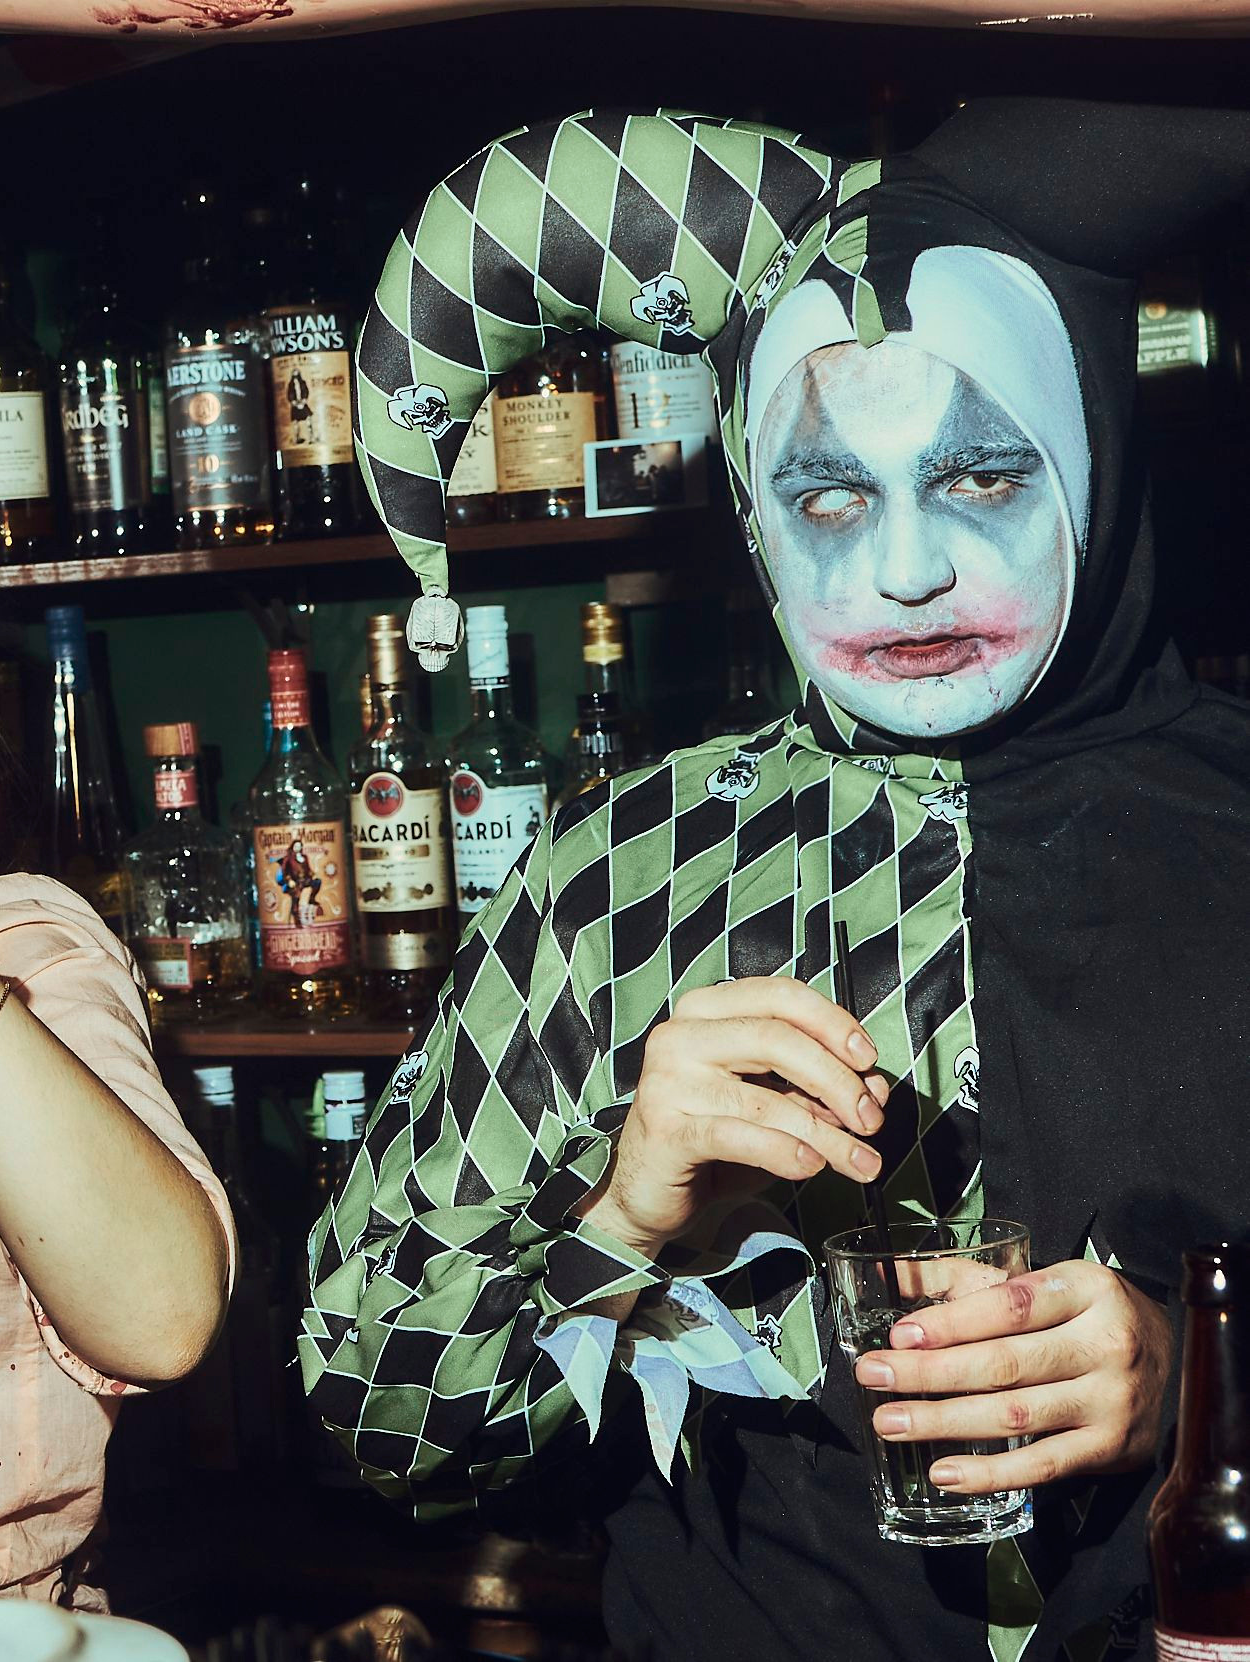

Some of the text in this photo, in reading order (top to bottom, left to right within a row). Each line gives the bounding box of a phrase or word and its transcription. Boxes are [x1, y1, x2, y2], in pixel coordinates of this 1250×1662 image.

[271, 331, 344, 354] WSON'S
[506, 398, 563, 412] MONKEY
[631, 389, 670, 429] 12
[0, 409, 25, 422] ILA
[503, 411, 570, 427] SHOULDER
[198, 454, 219, 473] 10
[456, 815, 512, 840] CARDÍ
